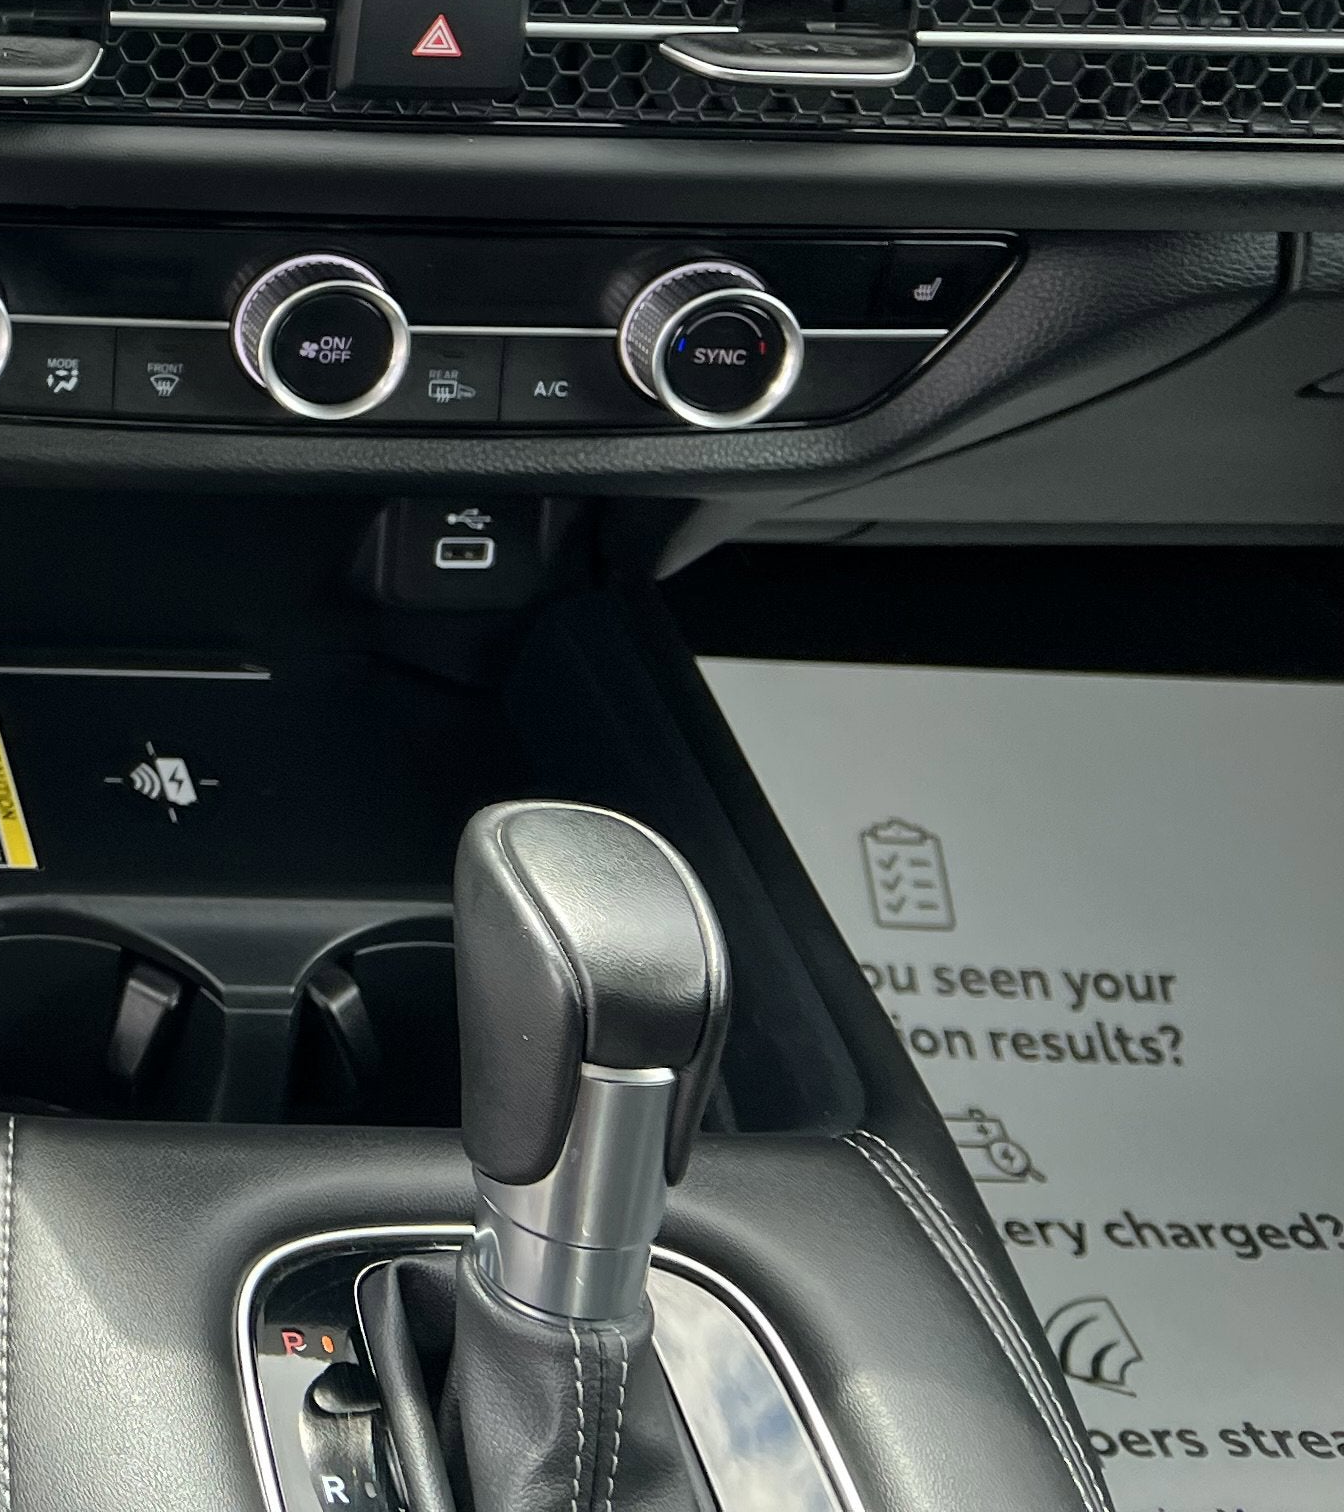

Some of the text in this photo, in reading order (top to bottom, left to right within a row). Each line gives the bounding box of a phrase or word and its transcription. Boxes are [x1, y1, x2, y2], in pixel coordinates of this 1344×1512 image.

[319, 337, 352, 351] ON/
[47, 359, 79, 371] MODE
[319, 350, 352, 364] OFF
[693, 348, 747, 366] SYNC
[147, 364, 183, 374] FRONT
[429, 370, 459, 378] REAR
[534, 381, 568, 397] A/C
[934, 966, 1053, 1000] seen
[1063, 970, 1176, 1011] your
[989, 1021, 1184, 1066] results?
[1104, 1209, 1344, 1260] charged?
[320, 1476, 350, 1504] R
